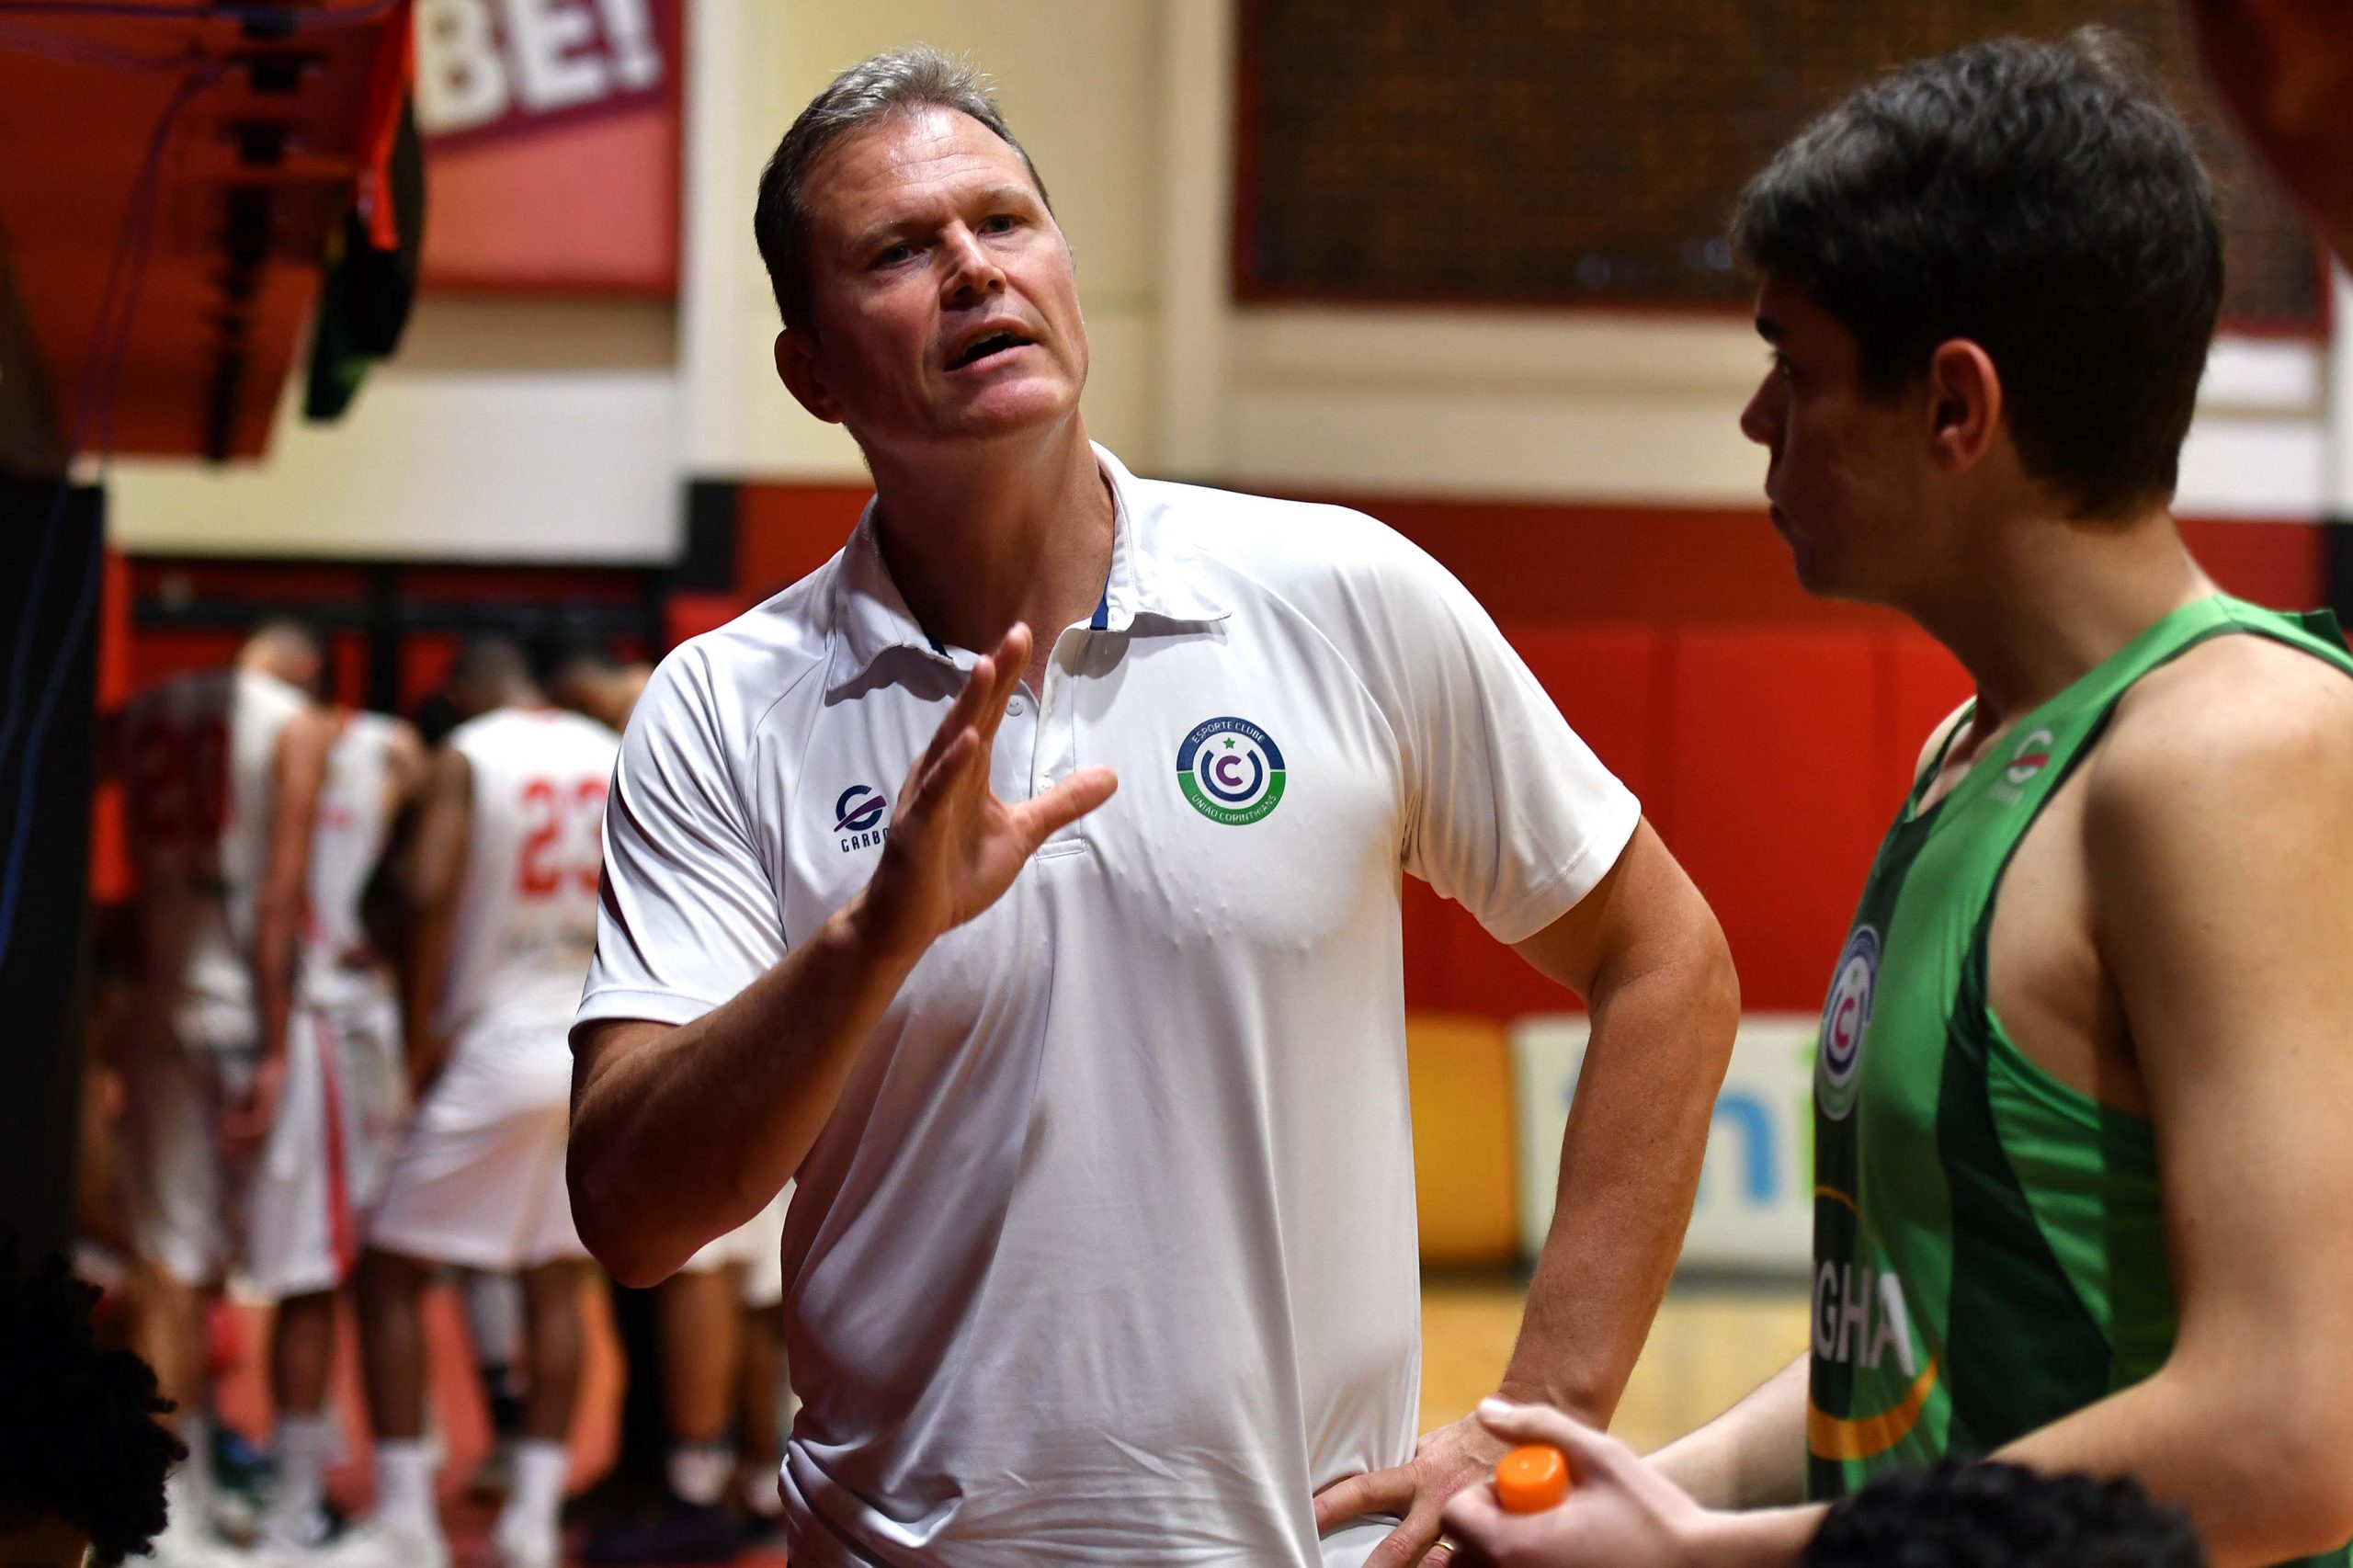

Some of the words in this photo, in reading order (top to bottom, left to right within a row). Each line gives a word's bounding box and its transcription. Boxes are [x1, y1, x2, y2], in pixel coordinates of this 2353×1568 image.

[415, 0, 662, 135] BE!
[1191, 722, 1233, 744] ESPORTE
[1234, 722, 1265, 744] CLUBE
[1220, 794, 1277, 822] CORINTHIANS
